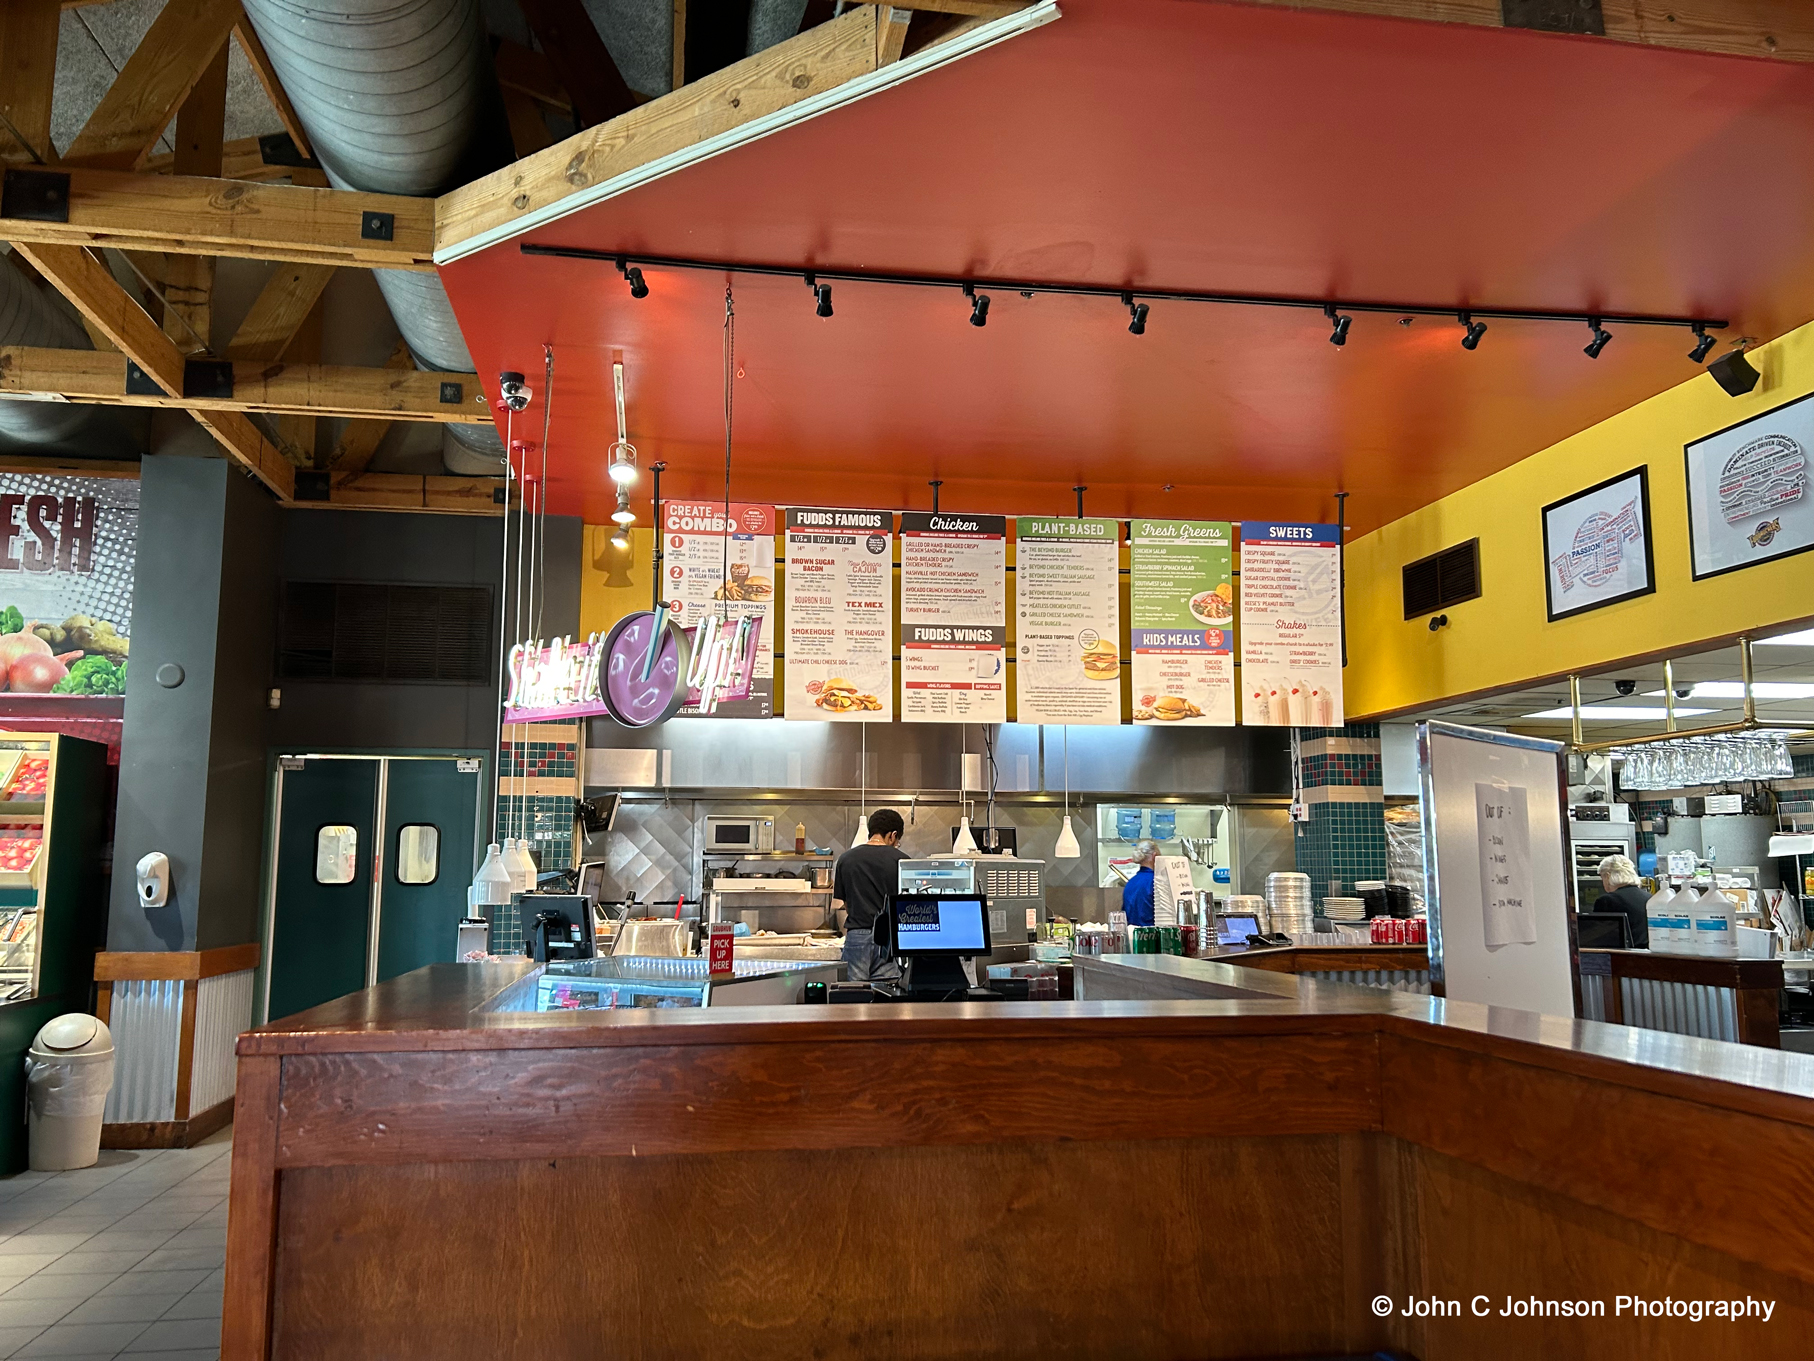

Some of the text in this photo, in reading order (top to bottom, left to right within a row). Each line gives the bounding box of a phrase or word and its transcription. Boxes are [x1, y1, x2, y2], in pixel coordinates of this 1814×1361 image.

[1765, 435, 1797, 449] COMMUNICATION
[1727, 441, 1775, 473] DOMINATE DRIVEN
[1720, 462, 1803, 494] PASSION TEAMWORK
[1780, 488, 1801, 499] PRIDE
[670, 505, 712, 517] CREATE
[667, 517, 737, 532] COMBO
[797, 512, 881, 527] FUDDS FAMOUS
[930, 517, 979, 531] Chicken
[1032, 523, 1104, 535] PLANT-BASED
[1141, 524, 1222, 541] Fresh Greens
[1270, 527, 1313, 538] SWEETS
[675, 537, 679, 547] 1
[1572, 542, 1600, 558] PASSION
[674, 568, 679, 577] 2
[1602, 565, 1618, 575] FOCUS
[673, 601, 679, 611] 3
[1275, 619, 1307, 630] Shakes
[915, 628, 993, 642] FUDDS WINGS
[1143, 634, 1166, 645] KIDS
[1168, 635, 1200, 646] MEALS
[906, 905, 937, 914] World's
[899, 913, 934, 923] Greatest
[714, 940, 729, 948] PICK
[717, 950, 727, 959] UP
[712, 961, 729, 970] HERE
